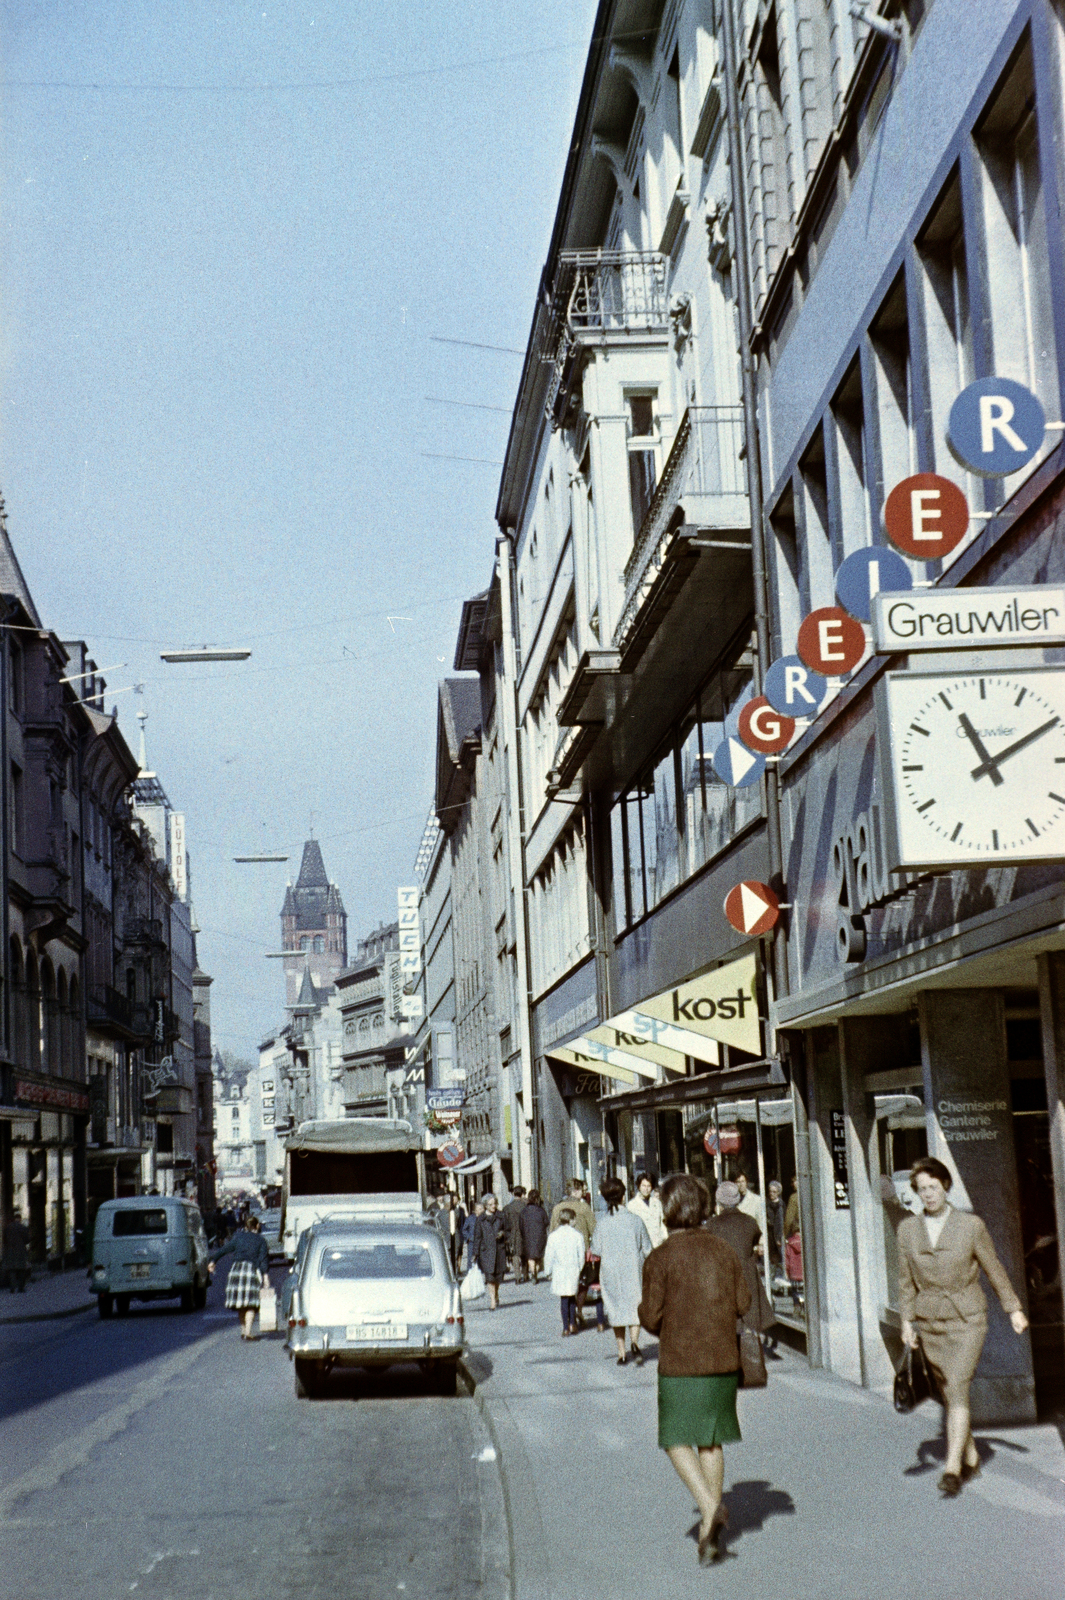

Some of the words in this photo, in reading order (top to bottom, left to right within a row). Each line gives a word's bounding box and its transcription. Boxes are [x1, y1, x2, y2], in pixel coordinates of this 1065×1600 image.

[749, 395, 1029, 742] GREIER
[887, 598, 1060, 638] Grauwiler
[400, 891, 418, 967] TUCH
[672, 987, 752, 1022] kost
[262, 1081, 275, 1124] PKZ
[428, 1096, 462, 1109] Claude
[938, 1099, 1007, 1113] Chemiserie
[939, 1114, 991, 1128] Ganterie
[942, 1129, 999, 1141] Grauwiler
